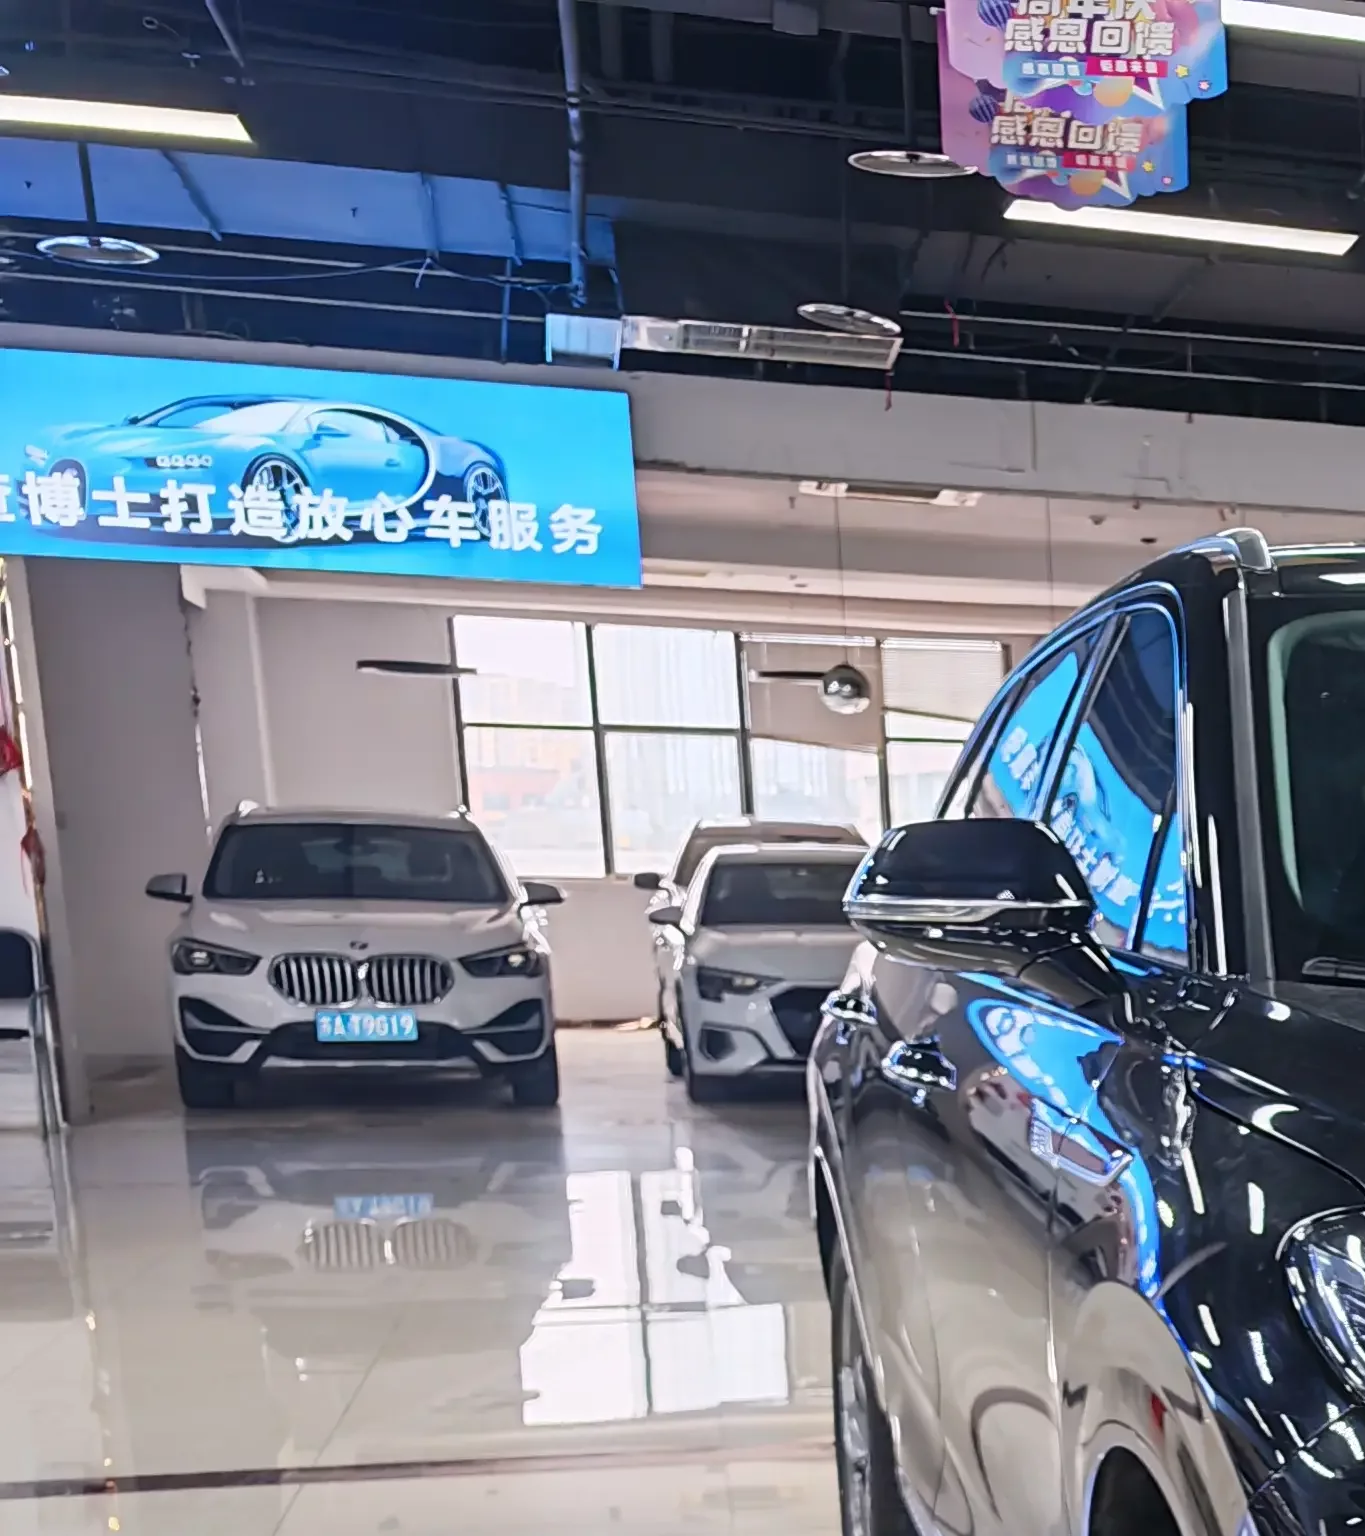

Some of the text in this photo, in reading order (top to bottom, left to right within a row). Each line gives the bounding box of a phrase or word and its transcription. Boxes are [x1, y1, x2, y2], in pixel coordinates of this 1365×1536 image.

[1004, 16, 1175, 56] 感恩回馈
[991, 114, 1143, 152] 感恩回馈
